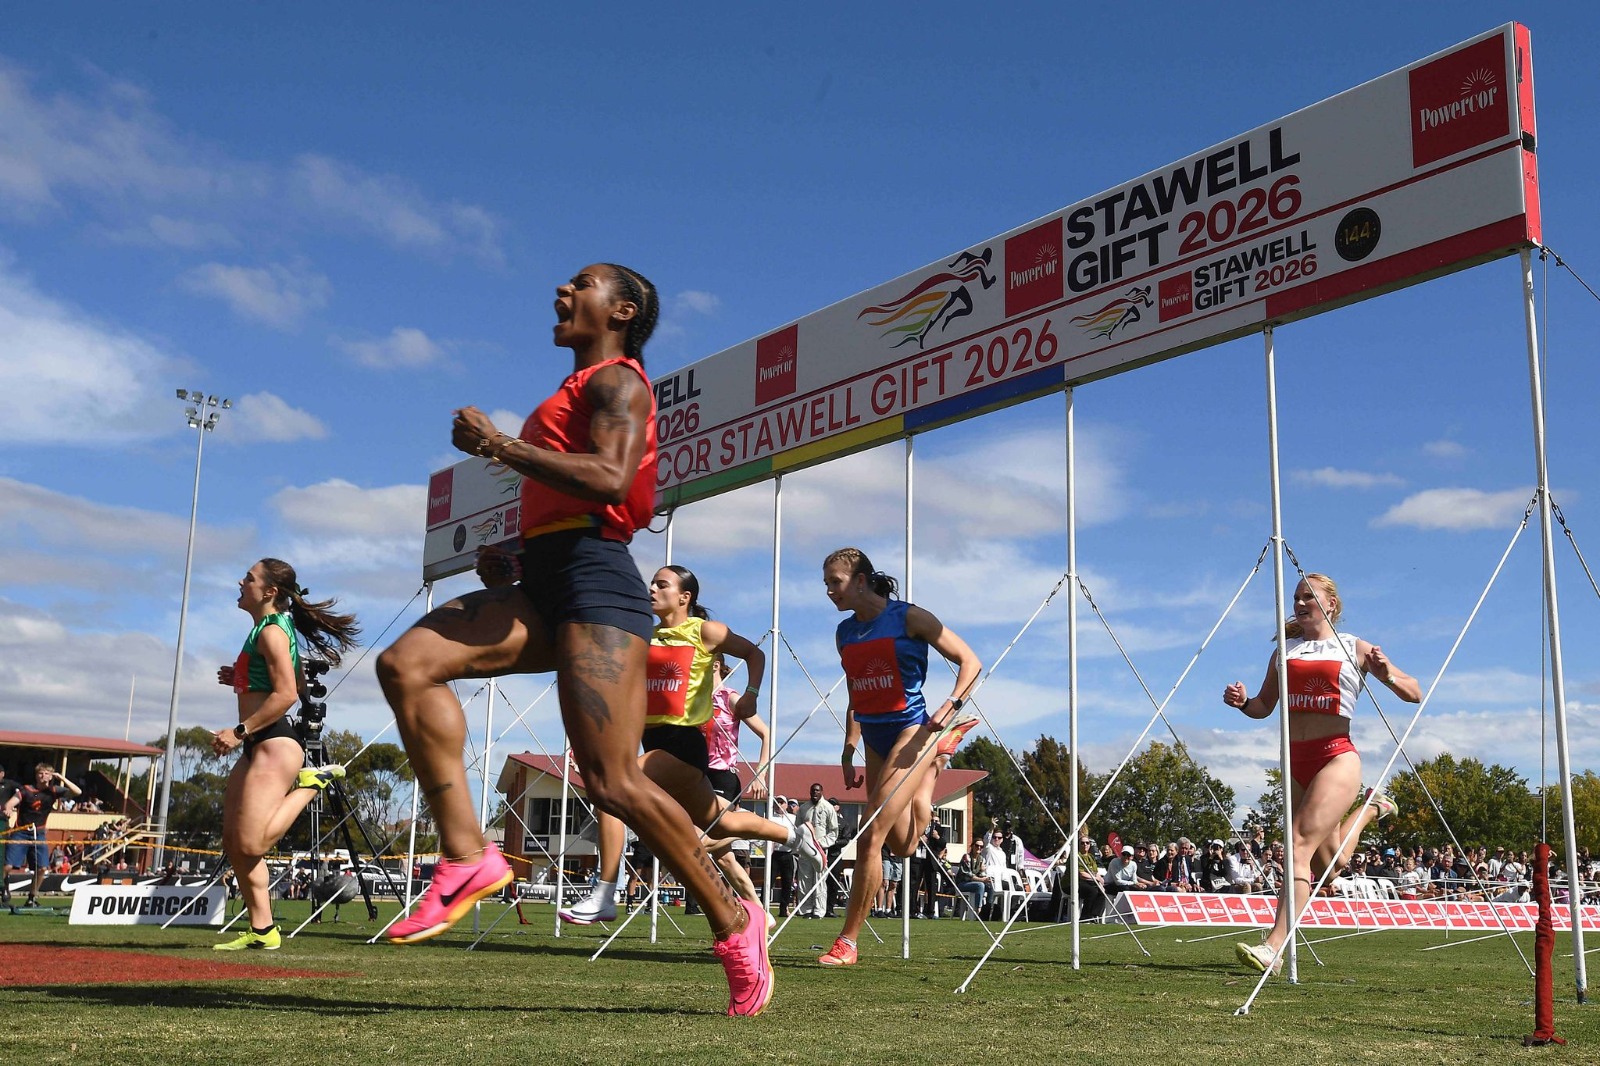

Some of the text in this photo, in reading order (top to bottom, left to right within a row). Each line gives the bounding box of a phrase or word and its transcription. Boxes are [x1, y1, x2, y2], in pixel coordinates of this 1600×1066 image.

[1420, 86, 1498, 133] Powercor
[1067, 127, 1301, 250] STAWELL
[1067, 174, 1302, 293] GIFT 2026
[1194, 230, 1317, 288] STAWELL
[1344, 221, 1370, 246] 144
[1010, 258, 1058, 290] Powercor
[1194, 253, 1318, 310] GIFT 2026
[719, 387, 861, 467] STAWELL
[871, 351, 953, 416] GIFT
[964, 318, 1058, 388] 2026
[759, 359, 793, 383] Powercor
[87, 896, 209, 916] POWERCOR
